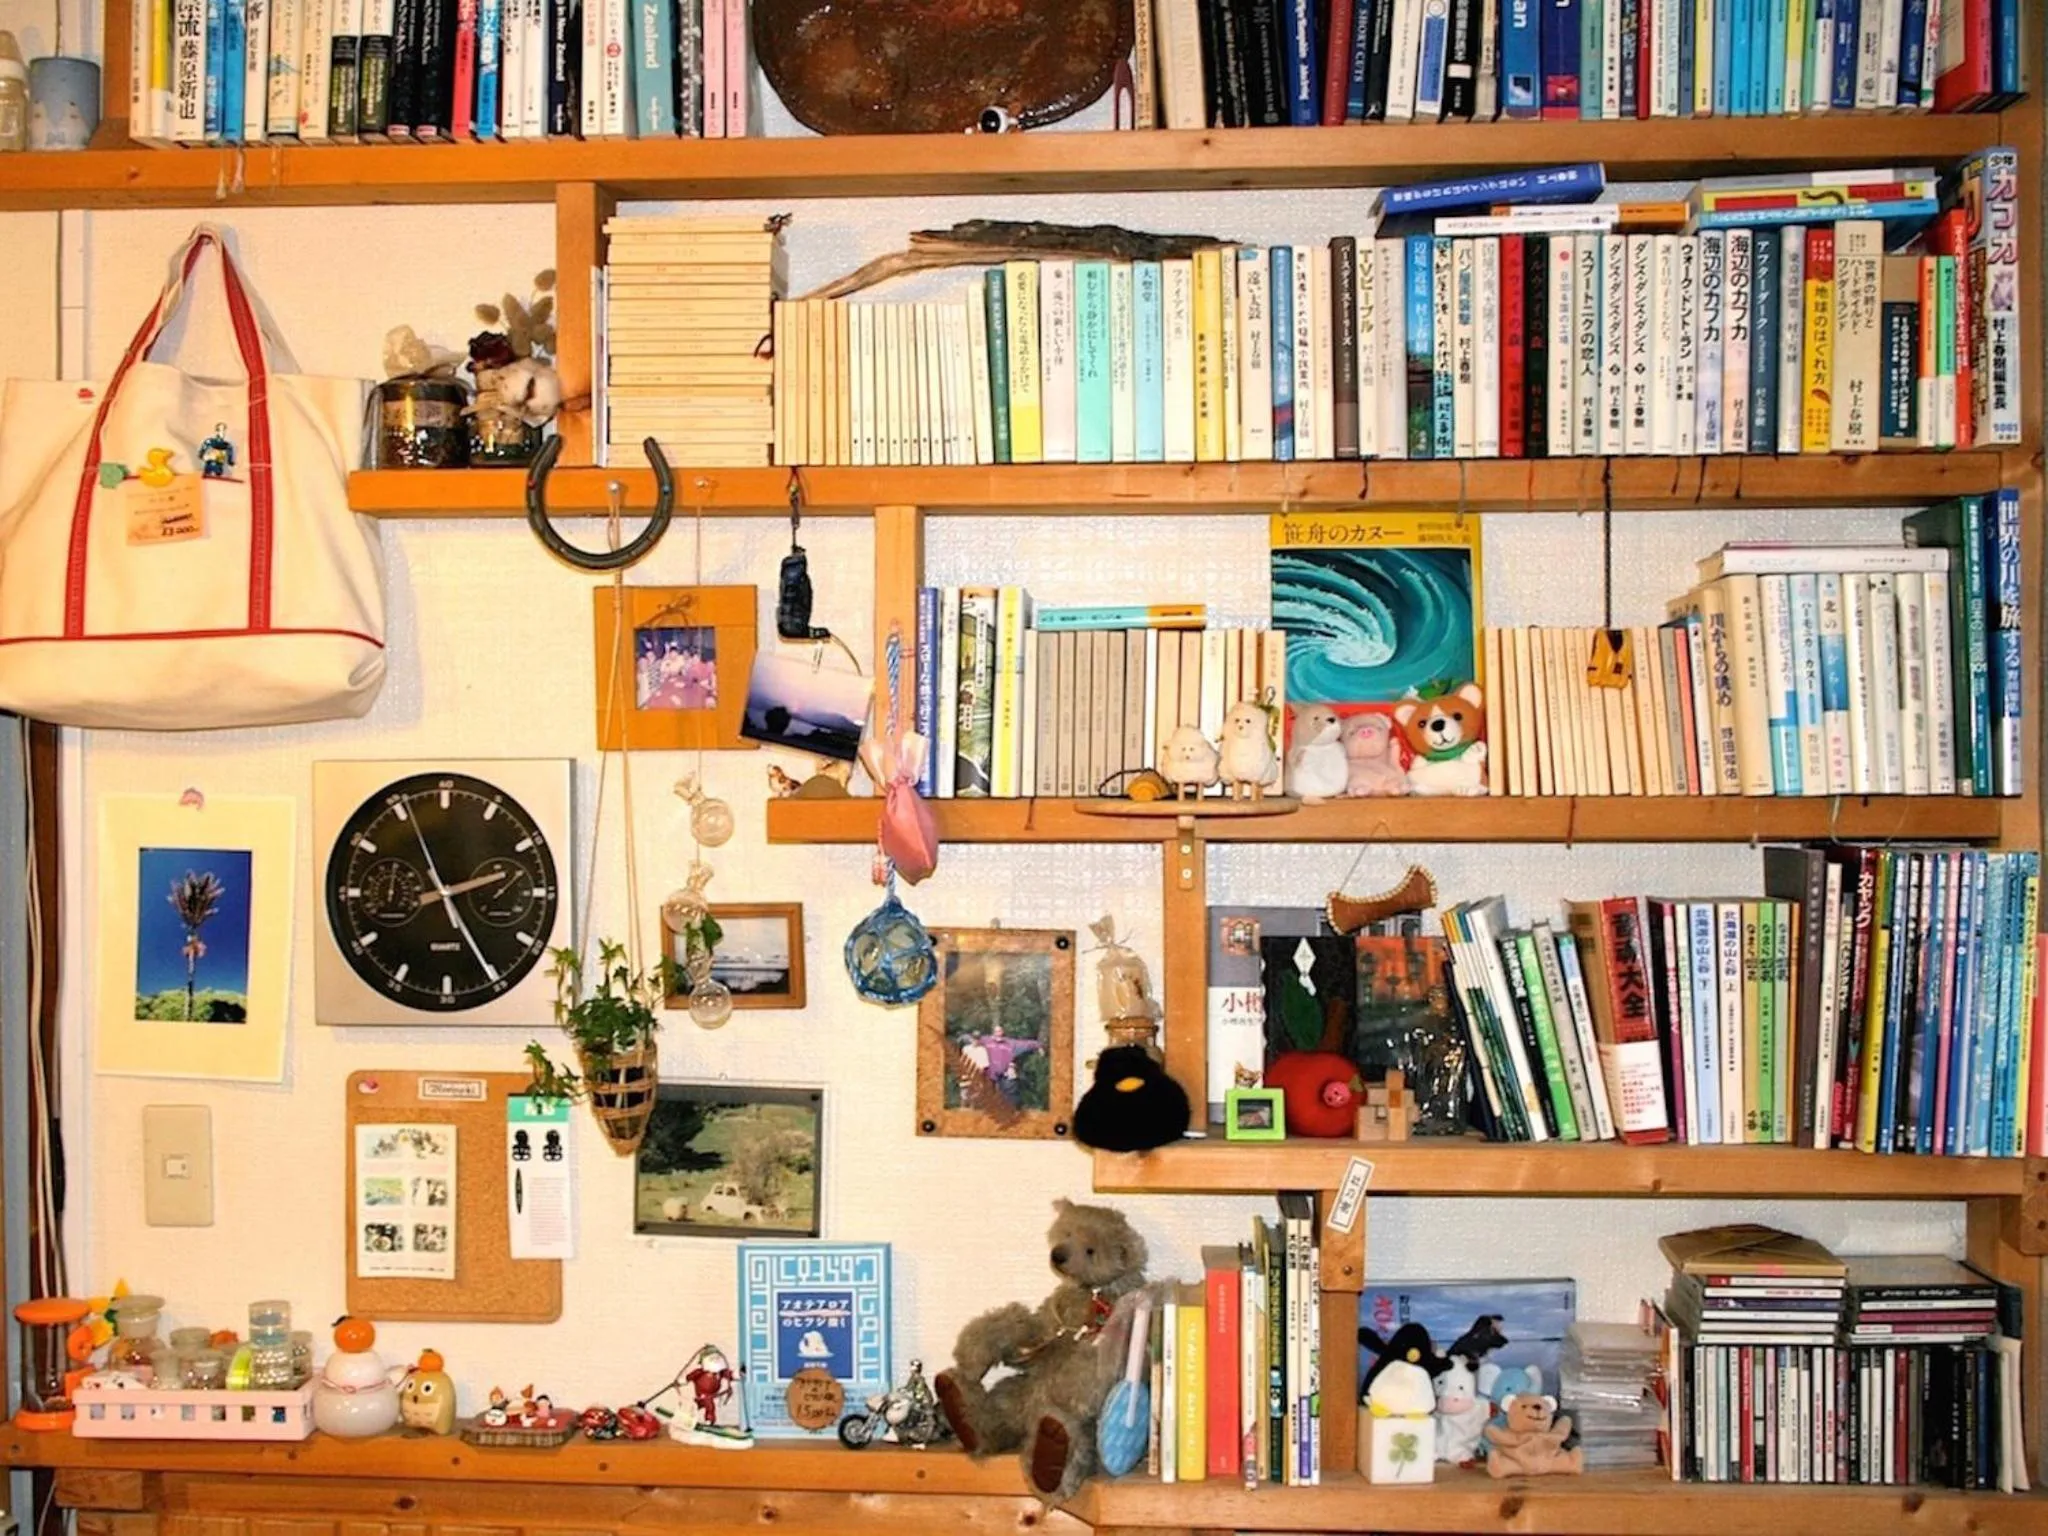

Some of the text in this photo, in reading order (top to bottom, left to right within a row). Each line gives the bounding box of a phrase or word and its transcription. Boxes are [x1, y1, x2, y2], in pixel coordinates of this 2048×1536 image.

[643, 4, 660, 69] Zealand
[1354, 9, 1369, 82] SHORT CUTS
[1703, 236, 1720, 342] 海辺のカフカ
[1731, 235, 1749, 341] 海辺のカフカ
[1837, 258, 1849, 332] ワンダーランド
[1864, 260, 1876, 329] 世界の終りと
[1459, 338, 1471, 384] 村上春樹
[1580, 251, 1595, 436] スプートニクの恋人 村上春樹
[1813, 285, 1829, 385] 地球のはぐれ方
[1610, 385, 1621, 428] 村上春樹
[1634, 384, 1645, 427] 村上春樹
[1848, 380, 1862, 436] 村上春樹
[1284, 522, 1405, 545] 笹舟のカヌー
[1999, 501, 2021, 668] 世界の川を旅する
[1709, 614, 1738, 780] 川からの眺め 野田知佑
[1856, 875, 1874, 928] カヤック
